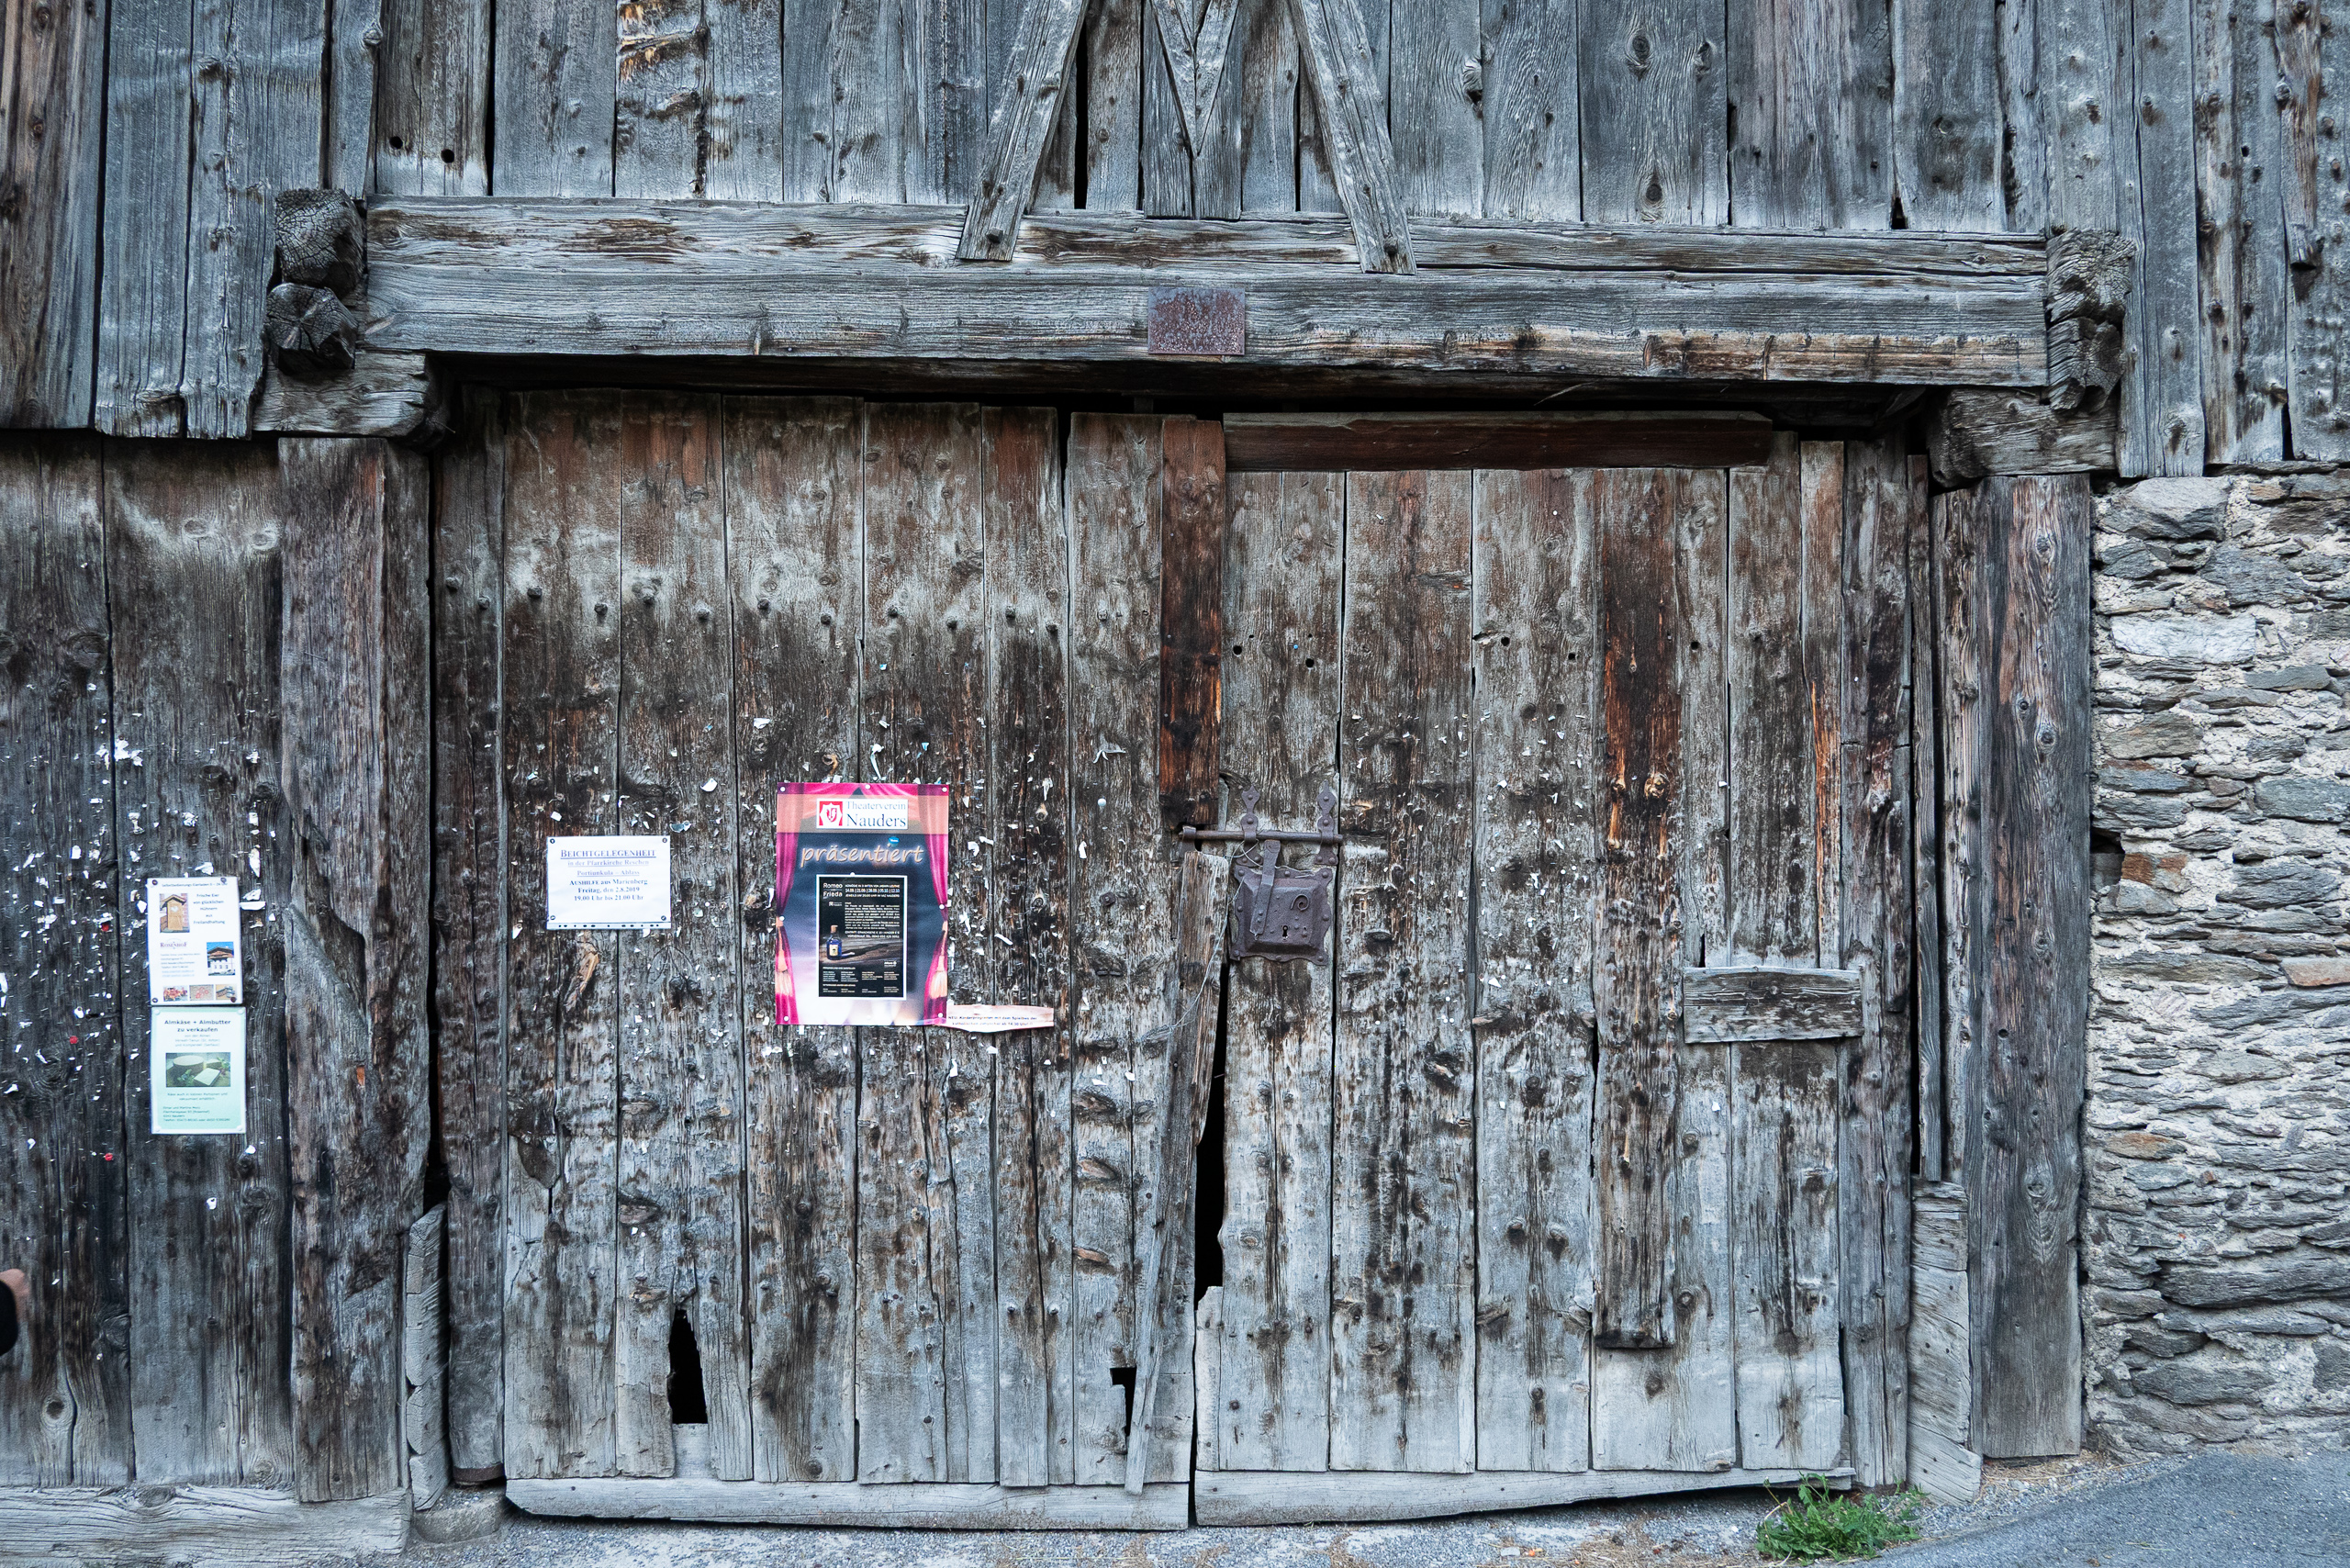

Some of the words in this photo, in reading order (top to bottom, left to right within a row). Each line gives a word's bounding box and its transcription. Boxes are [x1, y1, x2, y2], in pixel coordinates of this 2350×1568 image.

[846, 801, 906, 810] Theaterverein
[846, 813, 906, 827] Nauders
[800, 845, 924, 868] präsentiert
